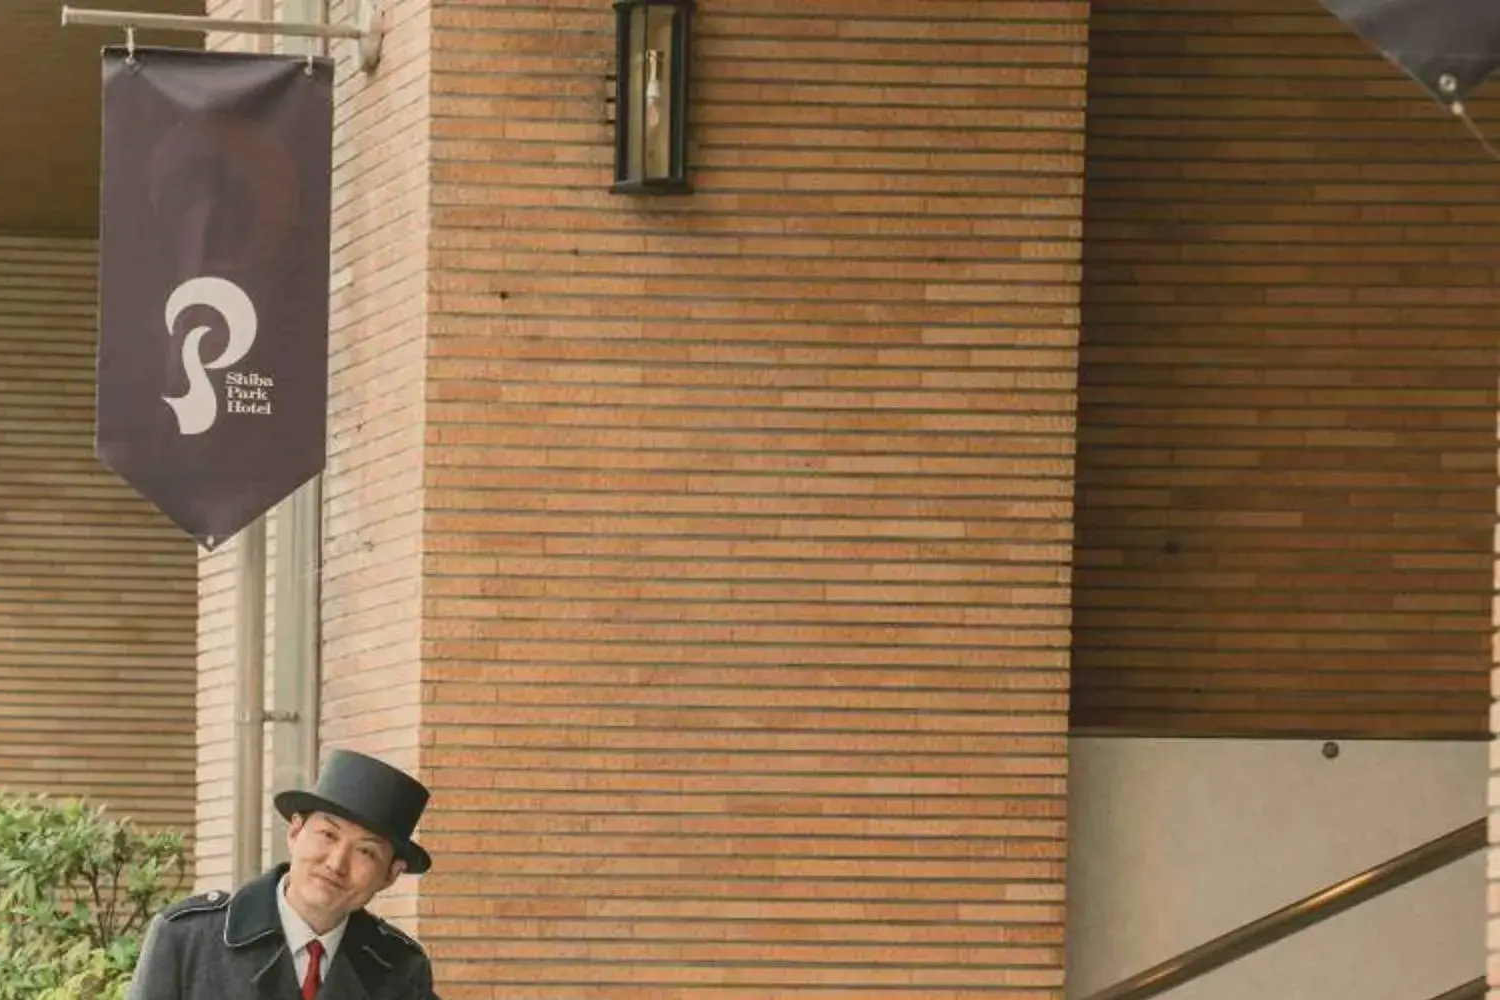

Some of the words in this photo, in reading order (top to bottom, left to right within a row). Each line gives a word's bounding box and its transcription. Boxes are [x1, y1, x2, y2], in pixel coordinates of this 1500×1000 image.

[226, 372, 274, 386] Shiba
[227, 386, 268, 400] Park
[227, 401, 272, 415] Hotel
